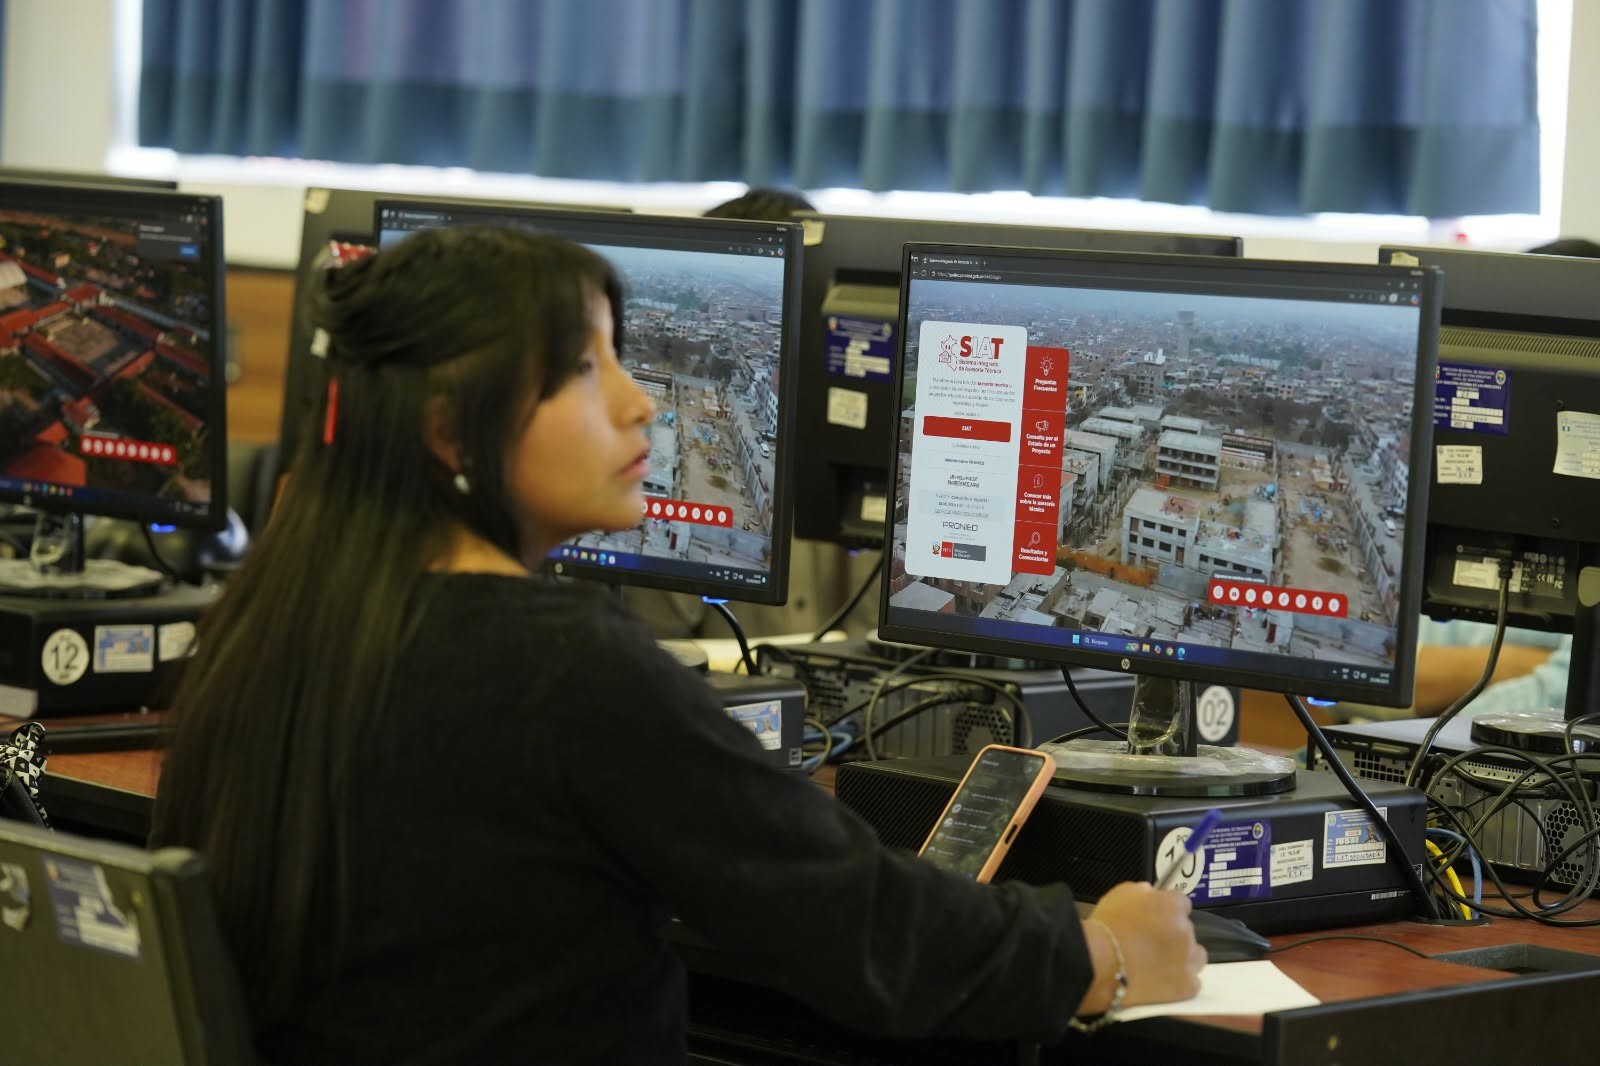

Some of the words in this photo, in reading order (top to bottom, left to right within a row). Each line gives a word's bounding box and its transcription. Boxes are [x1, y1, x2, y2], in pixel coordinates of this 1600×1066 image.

[959, 335, 1004, 359] SIAT
[1035, 378, 1057, 386] Preguntas
[1031, 447, 1051, 455] Proyecto
[1023, 491, 1042, 499] Conocer
[1020, 547, 1044, 555] Resultados
[1018, 554, 1049, 563] Convocatorias
[50, 643, 79, 671] 12
[1202, 699, 1229, 727] 02
